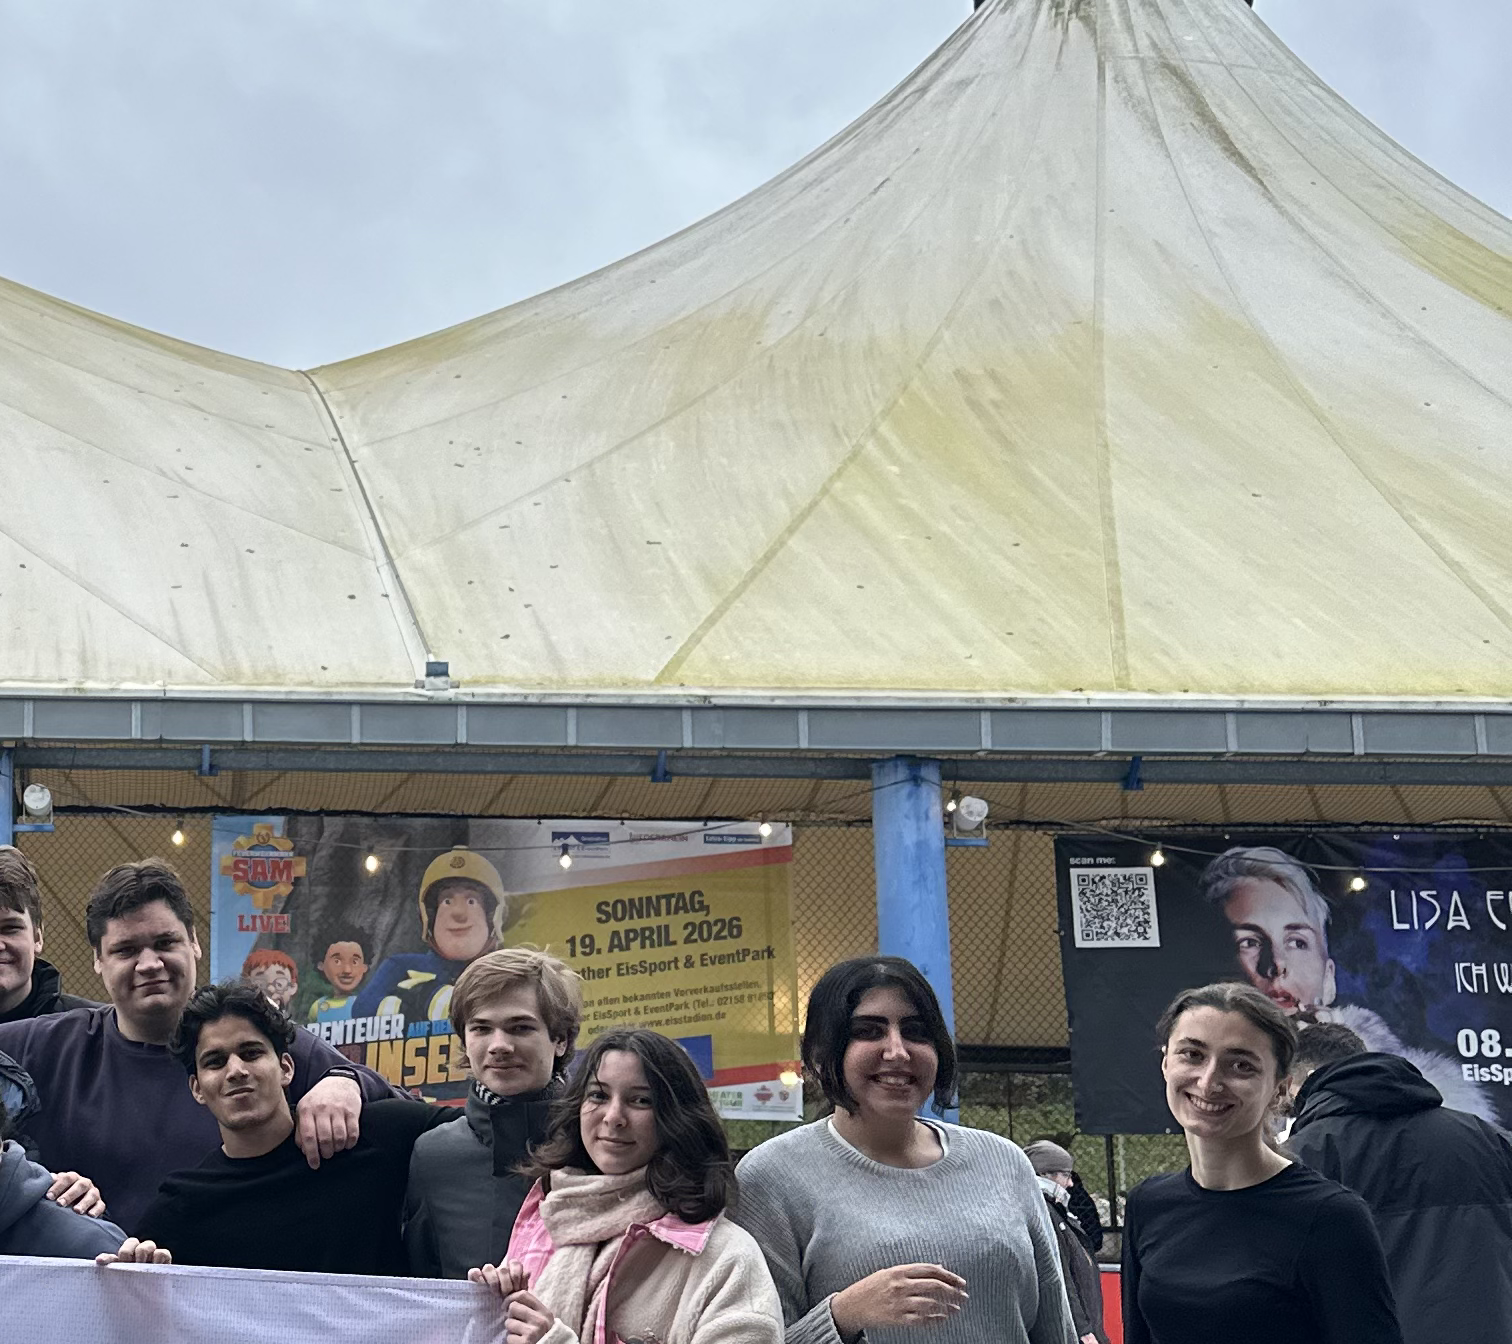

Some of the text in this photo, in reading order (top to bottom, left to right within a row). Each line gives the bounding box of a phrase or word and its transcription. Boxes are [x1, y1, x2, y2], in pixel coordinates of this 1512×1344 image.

[232, 857, 294, 883] SAM
[1070, 857, 1094, 865] scan
[596, 890, 710, 924] SONNTAG,
[1390, 889, 1471, 931] LISA
[237, 914, 291, 933] LIVE!
[566, 916, 743, 957] 19. APRIL 2026
[616, 957, 680, 978] EisSport
[684, 955, 695, 969] &
[700, 945, 776, 968] EventPark
[1454, 962, 1489, 994] ICH
[593, 1008, 632, 1020] EisSport
[643, 1000, 690, 1016] EventPark
[306, 1013, 405, 1048] BENTEUER
[408, 1022, 432, 1037] AUF
[1457, 1028, 1512, 1058] 08.
